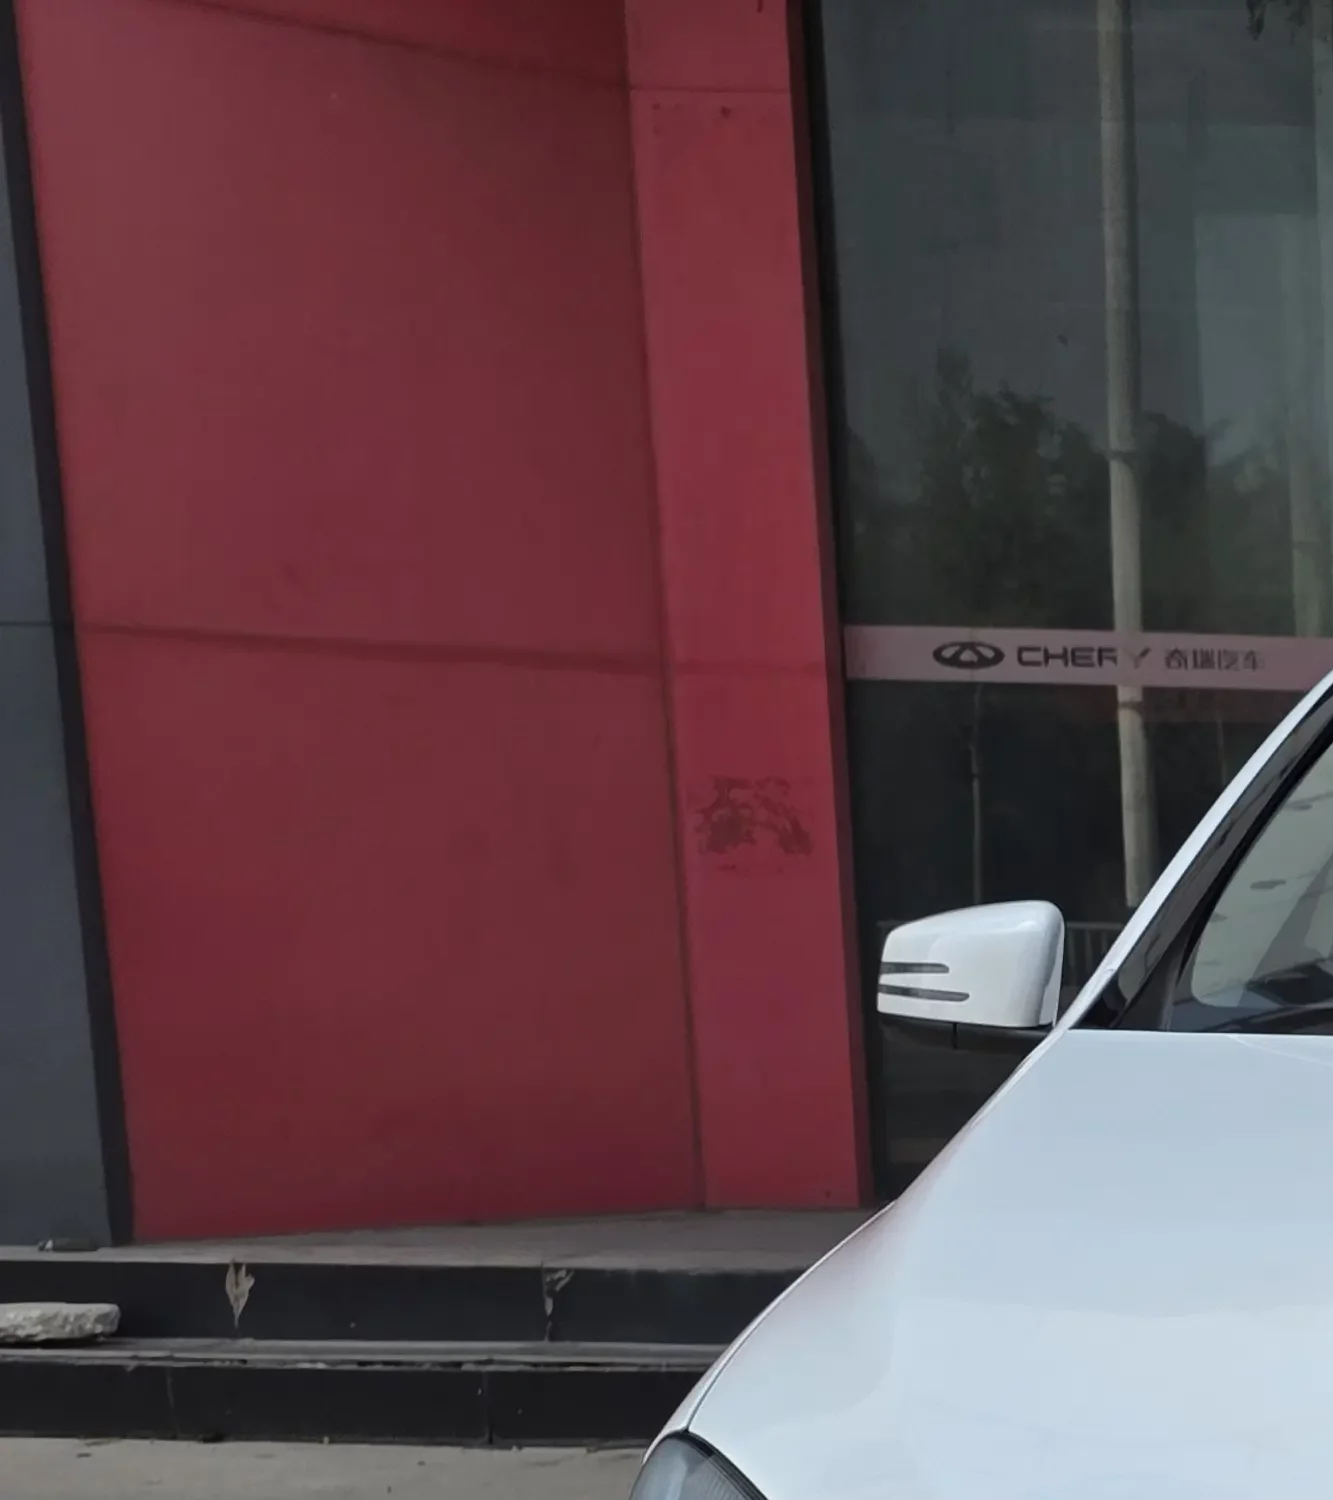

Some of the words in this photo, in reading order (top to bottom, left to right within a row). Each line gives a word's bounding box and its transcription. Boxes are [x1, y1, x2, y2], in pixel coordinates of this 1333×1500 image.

[1017, 646, 1151, 670] CHERY
[1164, 647, 1261, 672] 奇瑞汽车
